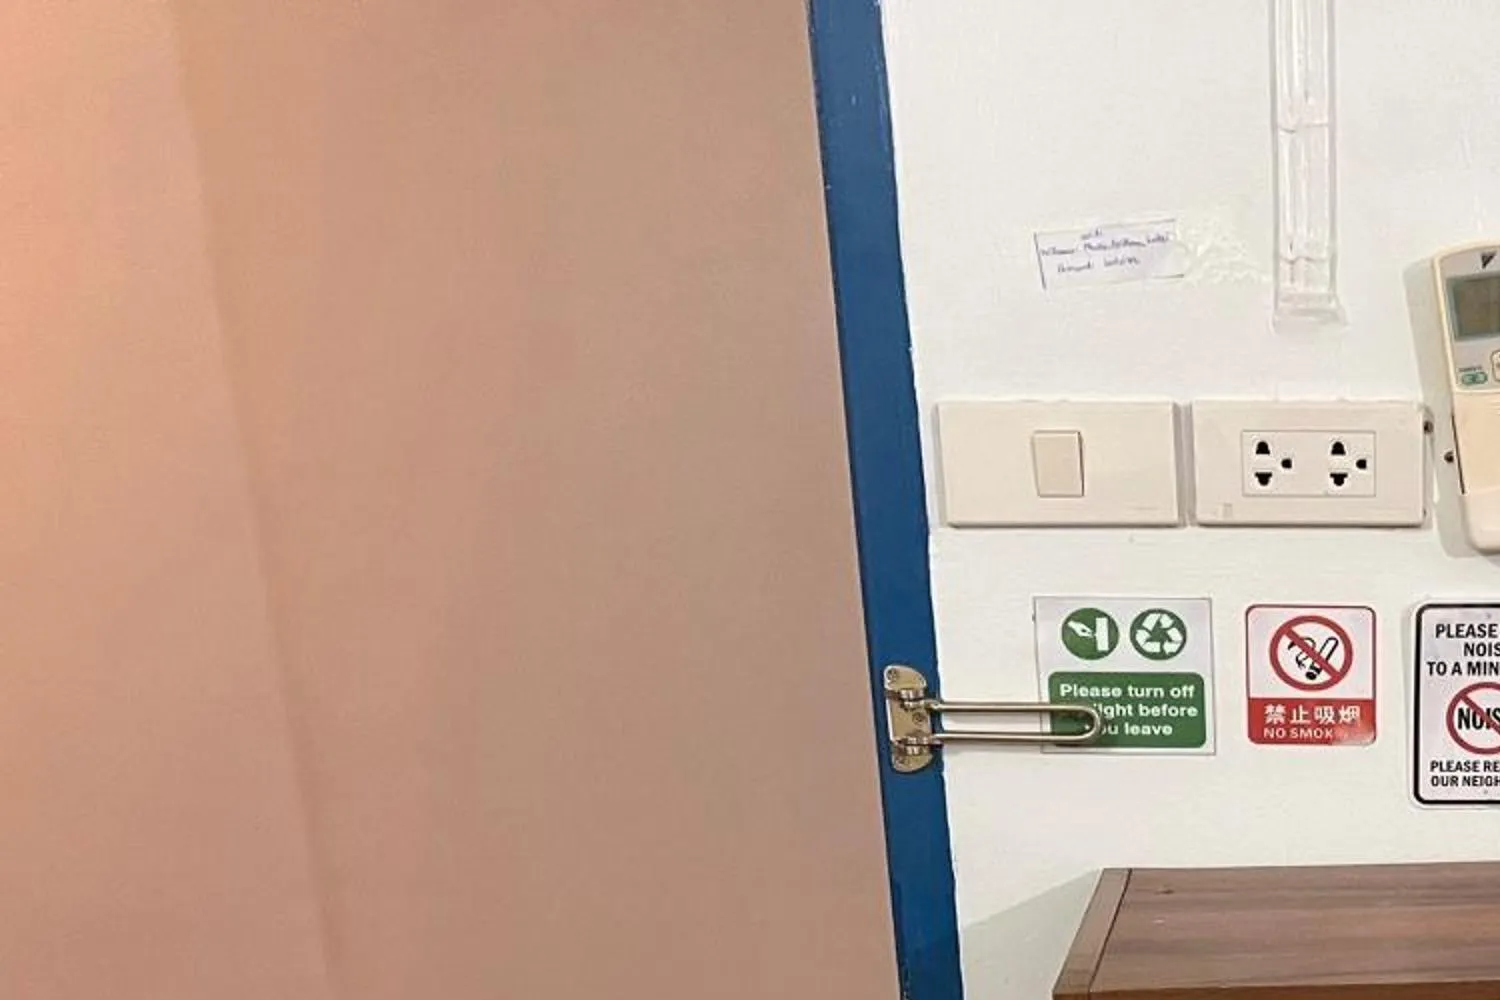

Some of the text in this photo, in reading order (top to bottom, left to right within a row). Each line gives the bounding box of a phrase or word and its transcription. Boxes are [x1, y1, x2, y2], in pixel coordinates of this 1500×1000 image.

[1435, 623, 1499, 639] PLEASE
[1426, 661, 1447, 676] TO
[1450, 661, 1463, 676] A
[1059, 683, 1196, 698] Please turn off
[1093, 703, 1199, 719] ight before
[1264, 703, 1361, 725] 禁止吸烟
[1123, 722, 1174, 736] leave
[1263, 727, 1286, 739] NO
[1430, 760, 1481, 772] PLEASE
[1431, 775, 1459, 787] OUR
